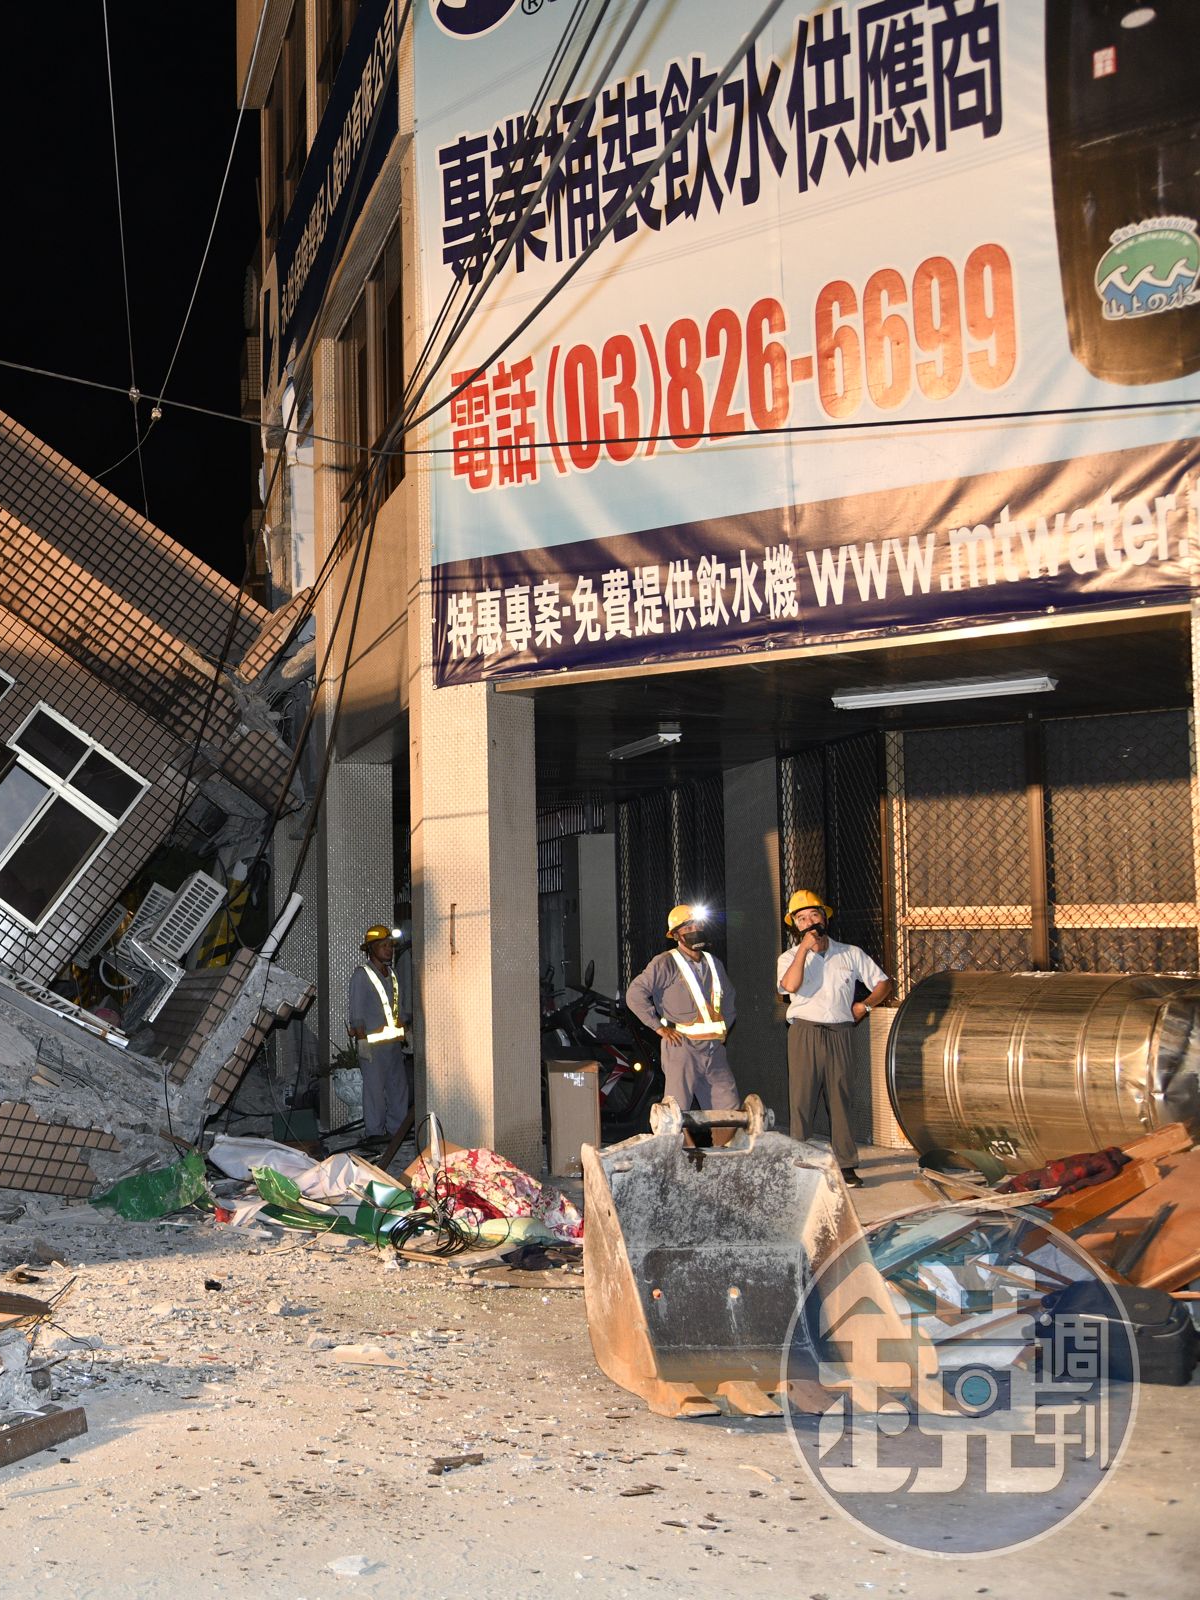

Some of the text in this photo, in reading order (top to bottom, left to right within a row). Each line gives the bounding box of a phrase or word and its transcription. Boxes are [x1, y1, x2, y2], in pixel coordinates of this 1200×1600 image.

[438, 0, 1002, 285] 專業桶裝飲水供應商
[449, 243, 1016, 491] 電話 (03)826-6699
